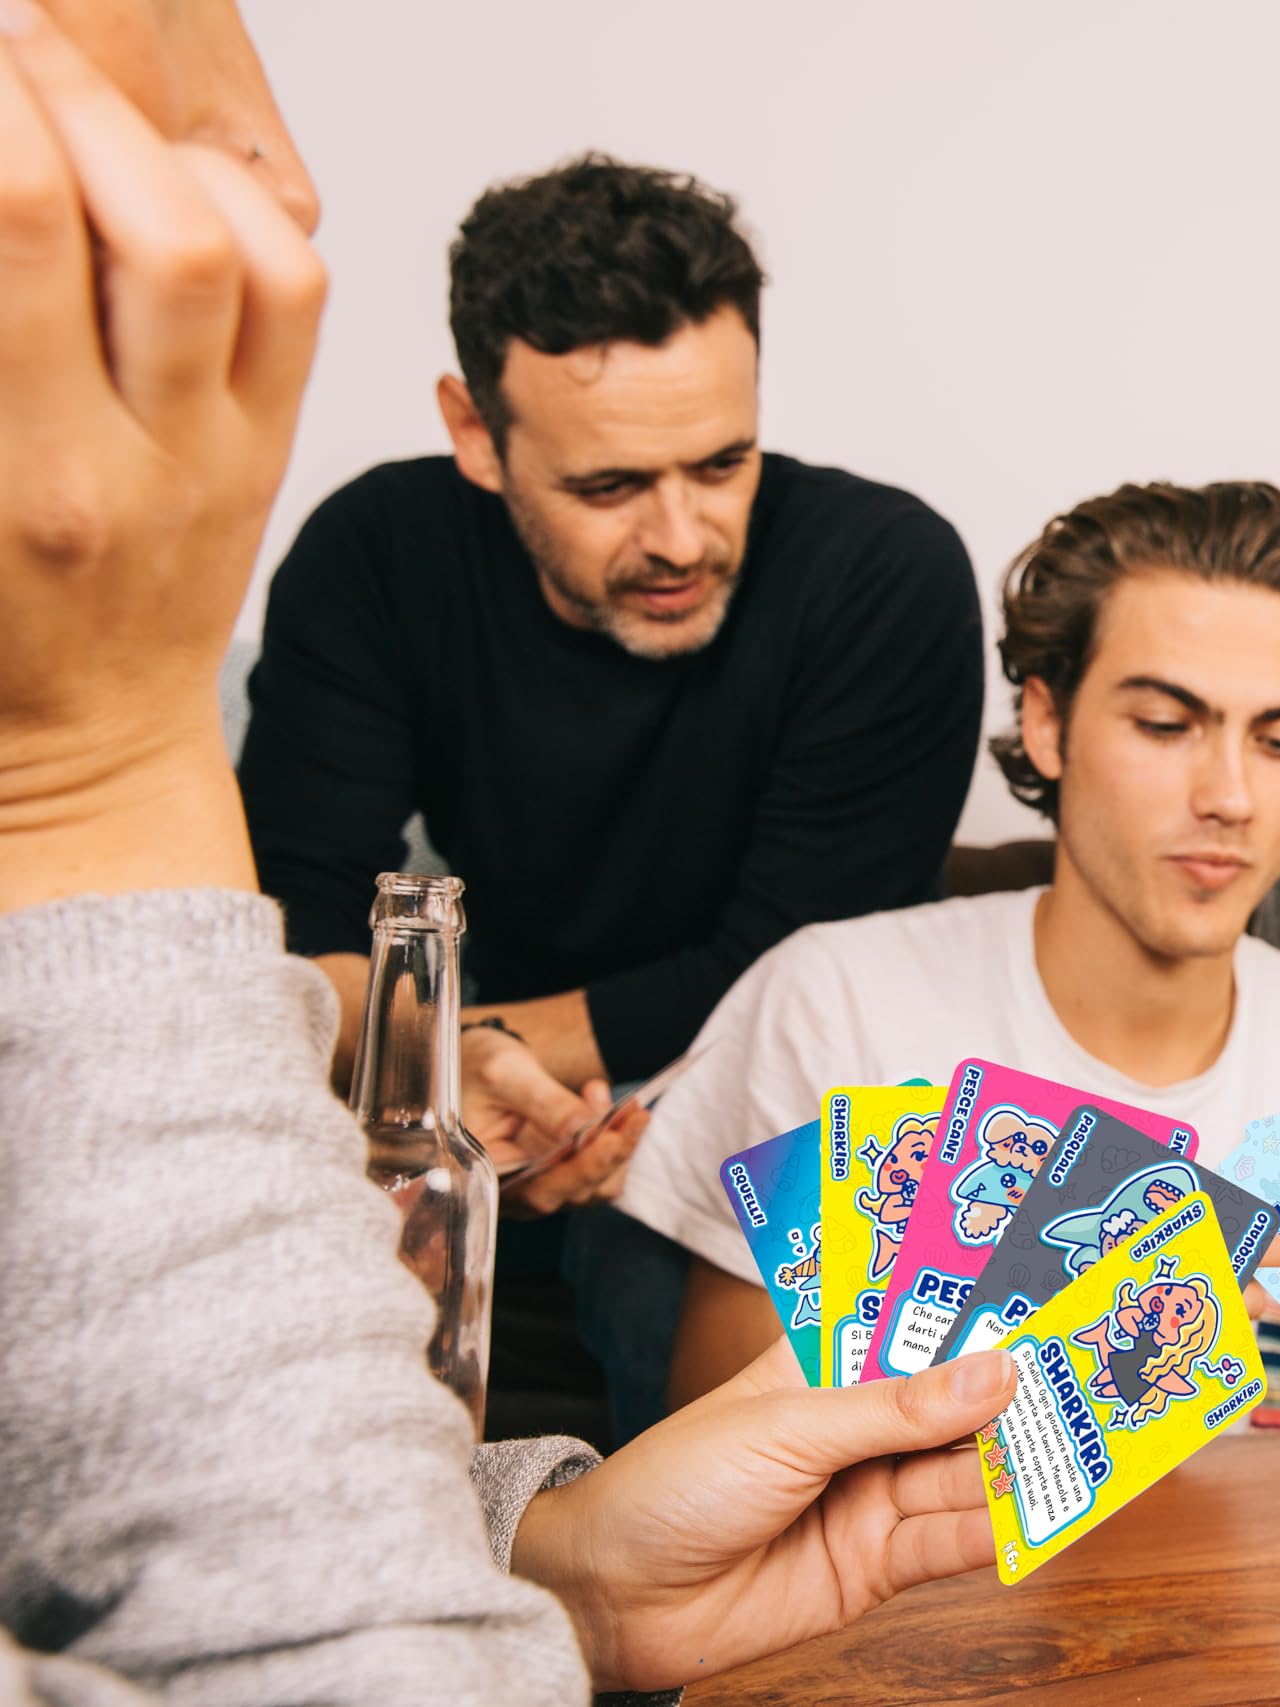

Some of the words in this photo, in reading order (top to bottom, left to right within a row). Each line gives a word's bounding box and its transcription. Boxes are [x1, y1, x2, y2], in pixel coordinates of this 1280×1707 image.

[834, 1098, 847, 1177] SHARKIRA
[1051, 1114, 1094, 1184] PASQUALO
[732, 1166, 765, 1226] SQUELLI!
[1133, 1204, 1202, 1258] SHARKIRA
[1232, 1213, 1268, 1273] ASQUALO
[913, 1306, 932, 1319] Che
[851, 1330, 861, 1340] Si
[908, 1321, 937, 1338] darti
[986, 1320, 1004, 1335] Non
[903, 1339, 931, 1354] mano.
[1012, 1396, 1025, 1416] uisci
[1041, 1342, 1107, 1483] SHARKIRA
[1207, 1381, 1261, 1425] SHARKIRA
[1006, 1417, 1014, 1432] una
[1021, 1416, 1028, 1426] le
[1023, 1351, 1031, 1361] Si
[1027, 1361, 1041, 1388] Balla!
[1039, 1389, 1051, 1410] Ogni
[1045, 1412, 1066, 1453] giocatore
[1063, 1454, 1077, 1482] mette
[1072, 1484, 1083, 1503] una
[1014, 1440, 1025, 1464] testa
[1022, 1385, 1038, 1417] coperta
[1035, 1420, 1046, 1433] sul
[1041, 1433, 1054, 1464] tavolo.
[1052, 1464, 1068, 1503] Mescola
[1023, 1429, 1036, 1453] carte
[1023, 1474, 1033, 1488] chi
[1032, 1456, 1048, 1491] coperte
[1027, 1488, 1038, 1511] vuoi.
[1044, 1494, 1055, 1521] senza
